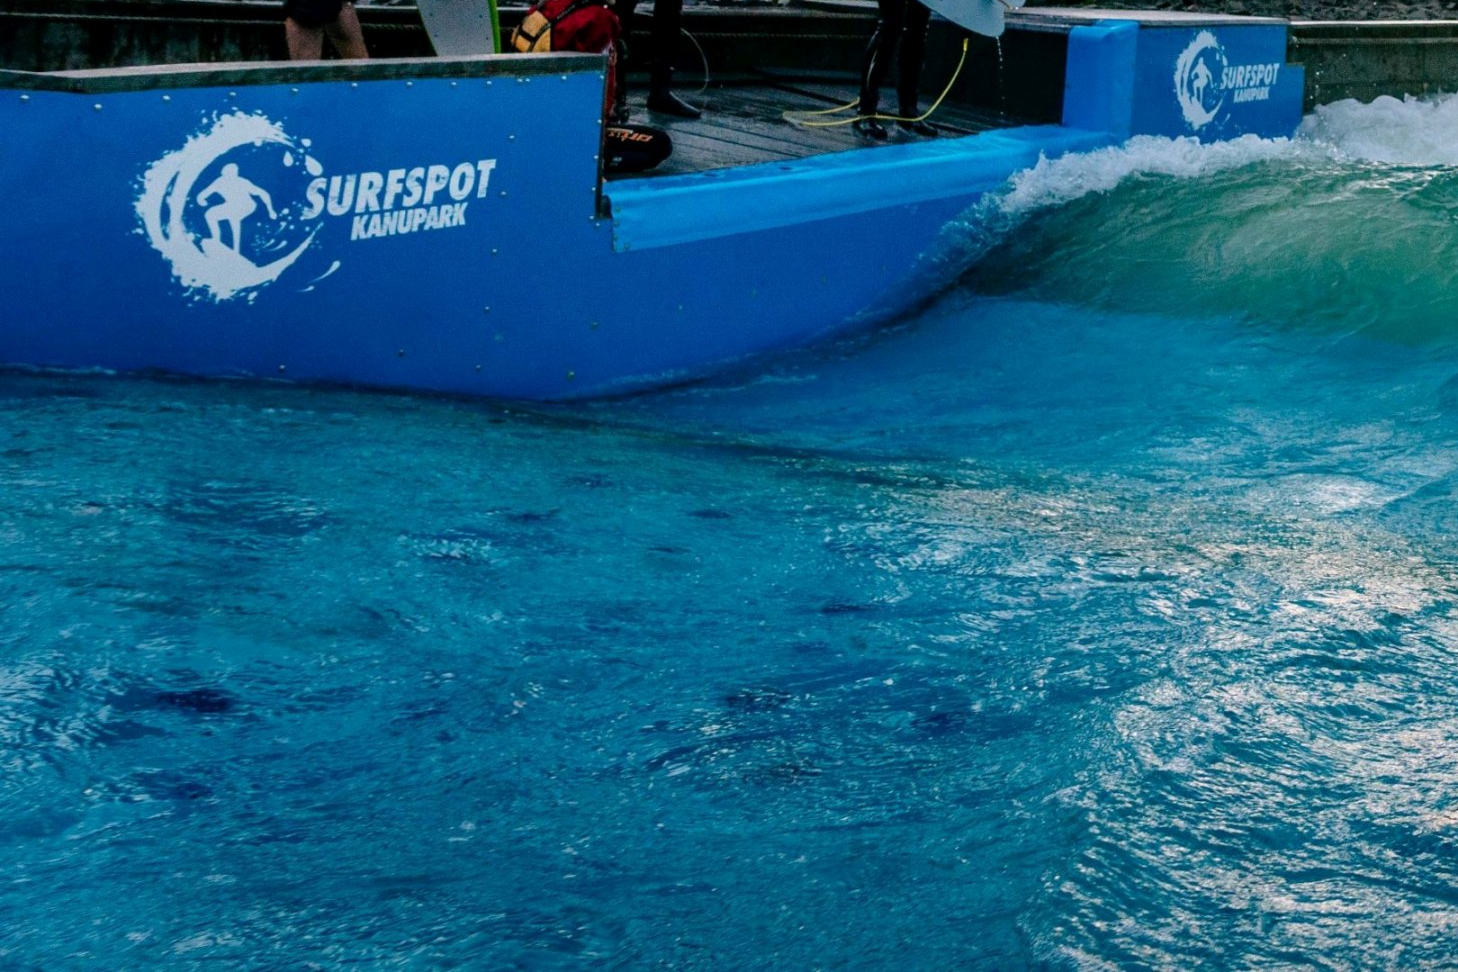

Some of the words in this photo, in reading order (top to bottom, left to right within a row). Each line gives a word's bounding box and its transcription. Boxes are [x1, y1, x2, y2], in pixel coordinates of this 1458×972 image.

[1219, 63, 1280, 90] SURFSPOT
[301, 158, 497, 220] SURFSPOT
[350, 202, 469, 241] KANUPARK
